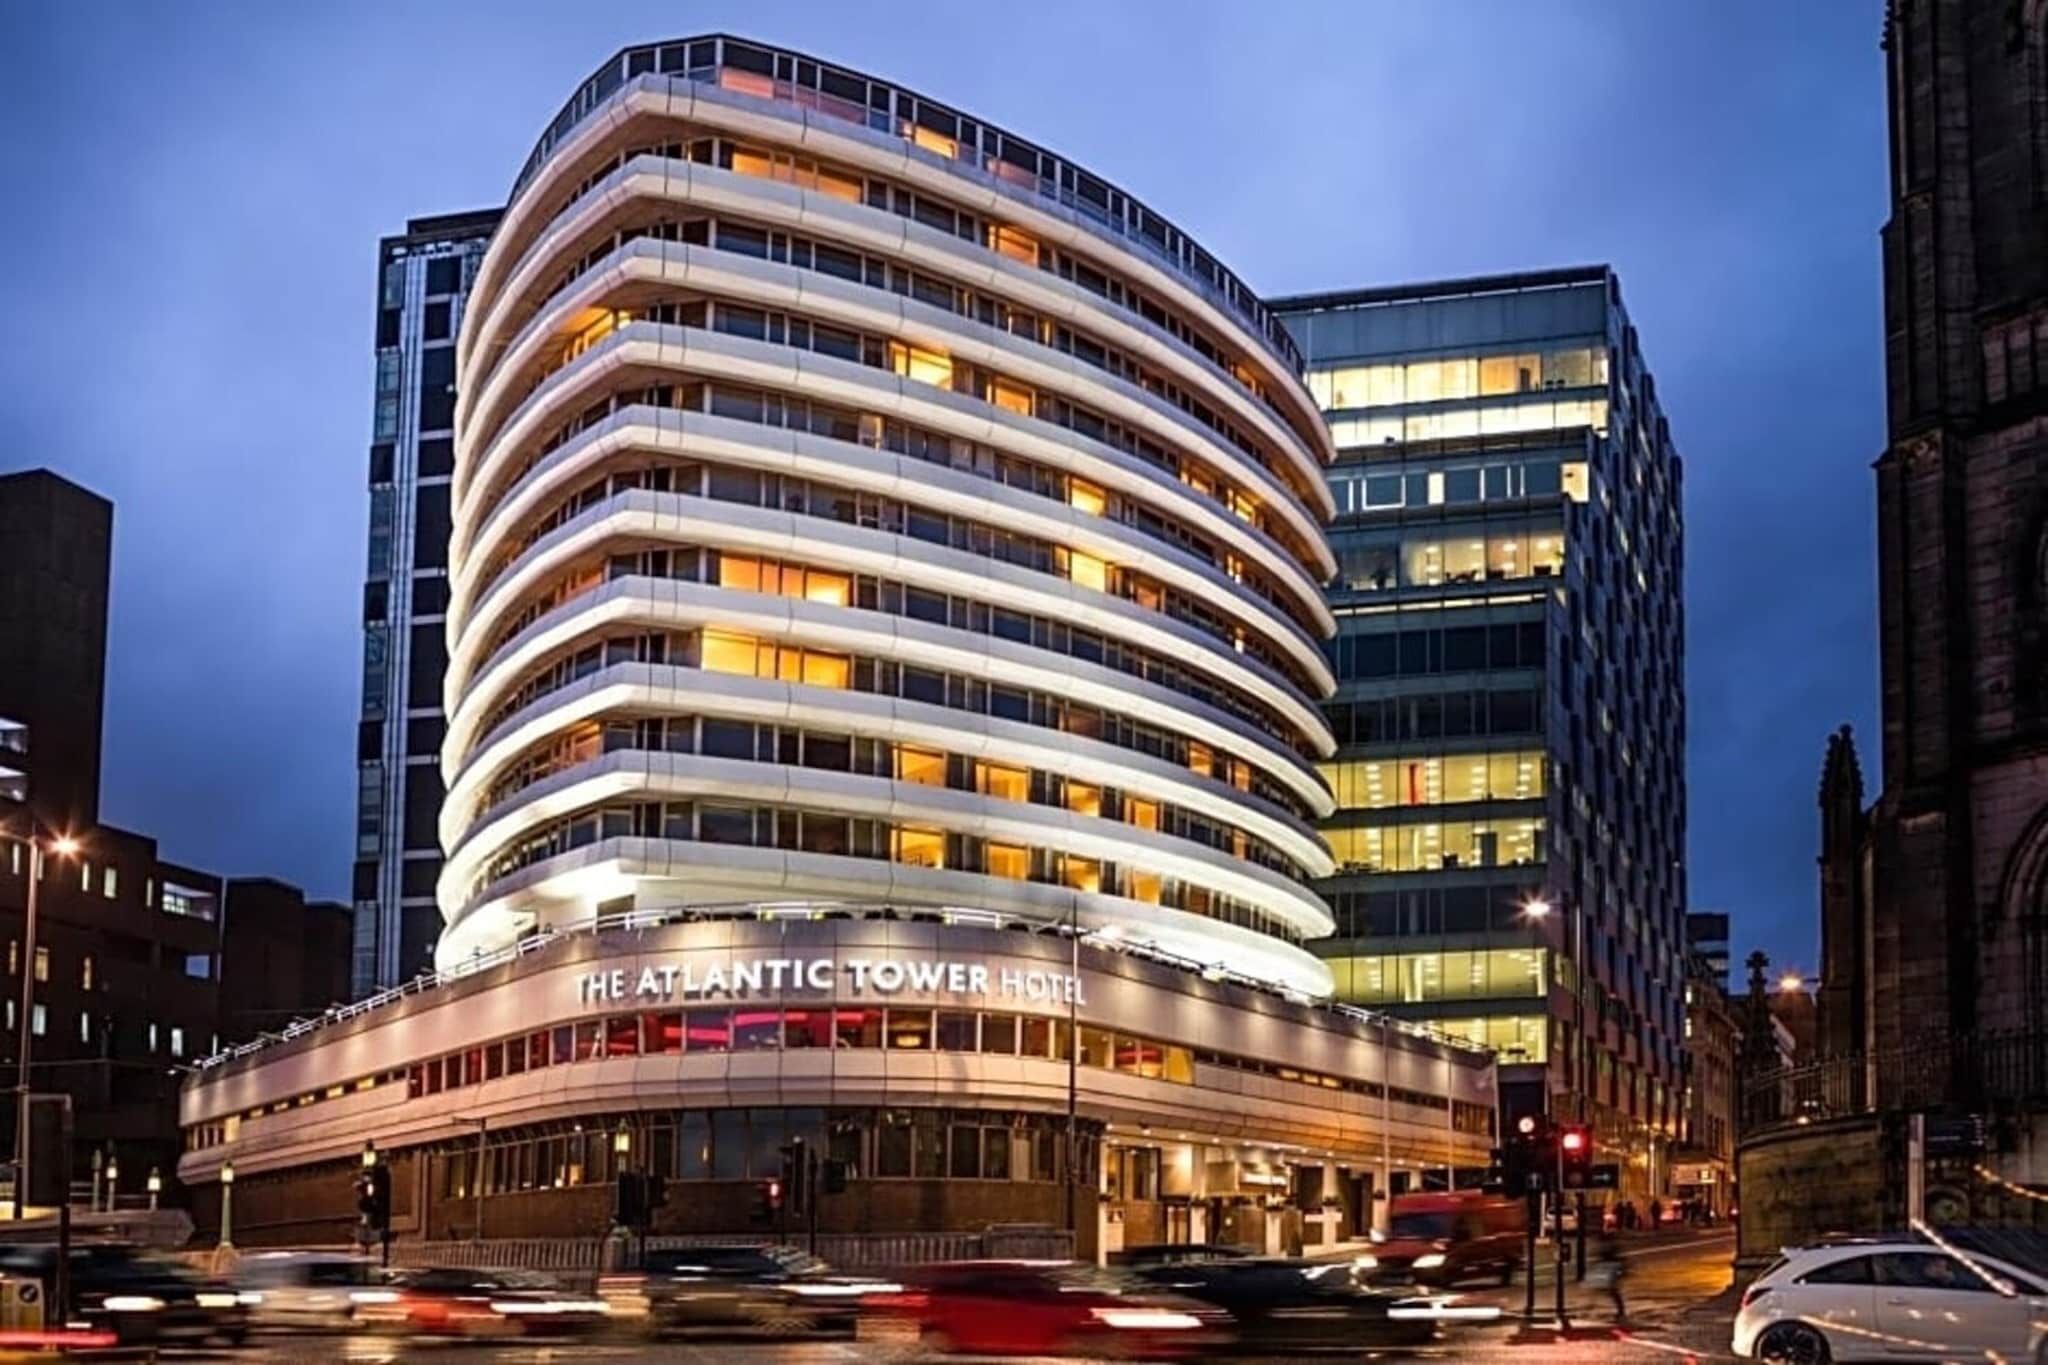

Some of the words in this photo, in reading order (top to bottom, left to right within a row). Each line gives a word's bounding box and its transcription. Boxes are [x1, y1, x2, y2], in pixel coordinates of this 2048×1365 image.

[576, 969, 624, 1002] THE
[636, 959, 834, 995] ATLANTIC
[848, 959, 988, 993] TOWER
[1001, 968, 1087, 1006] HOTEL
